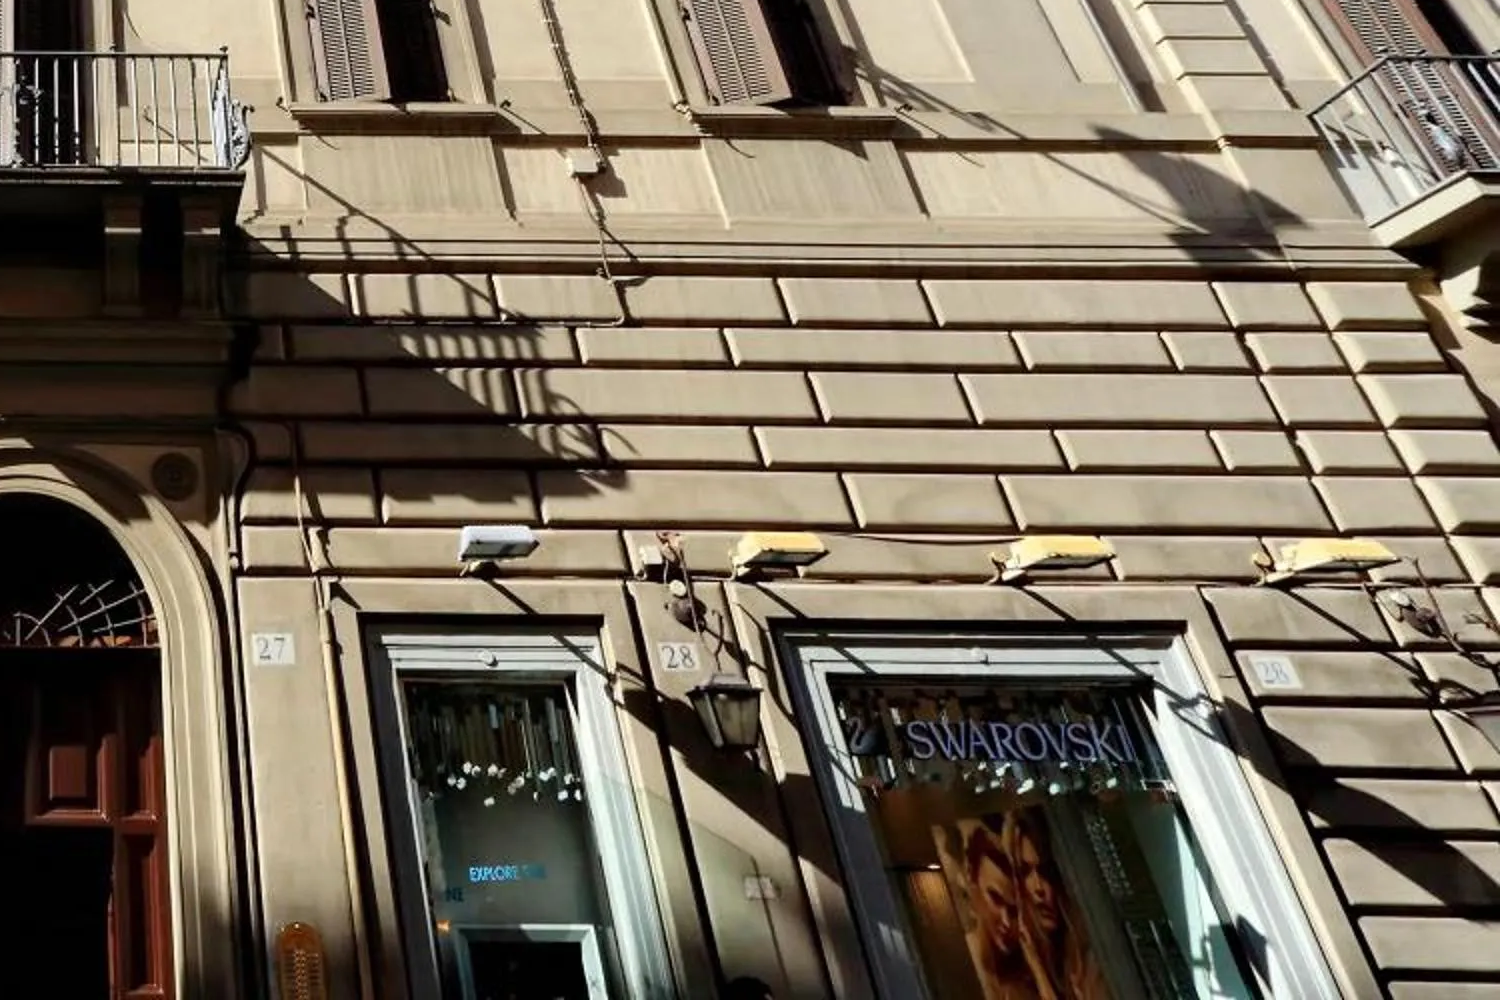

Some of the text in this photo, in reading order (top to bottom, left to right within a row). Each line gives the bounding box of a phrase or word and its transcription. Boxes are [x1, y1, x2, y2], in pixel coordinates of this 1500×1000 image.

[256, 636, 285, 660] 27
[661, 645, 695, 668] 28
[906, 717, 1136, 762] SWAROVSKI
